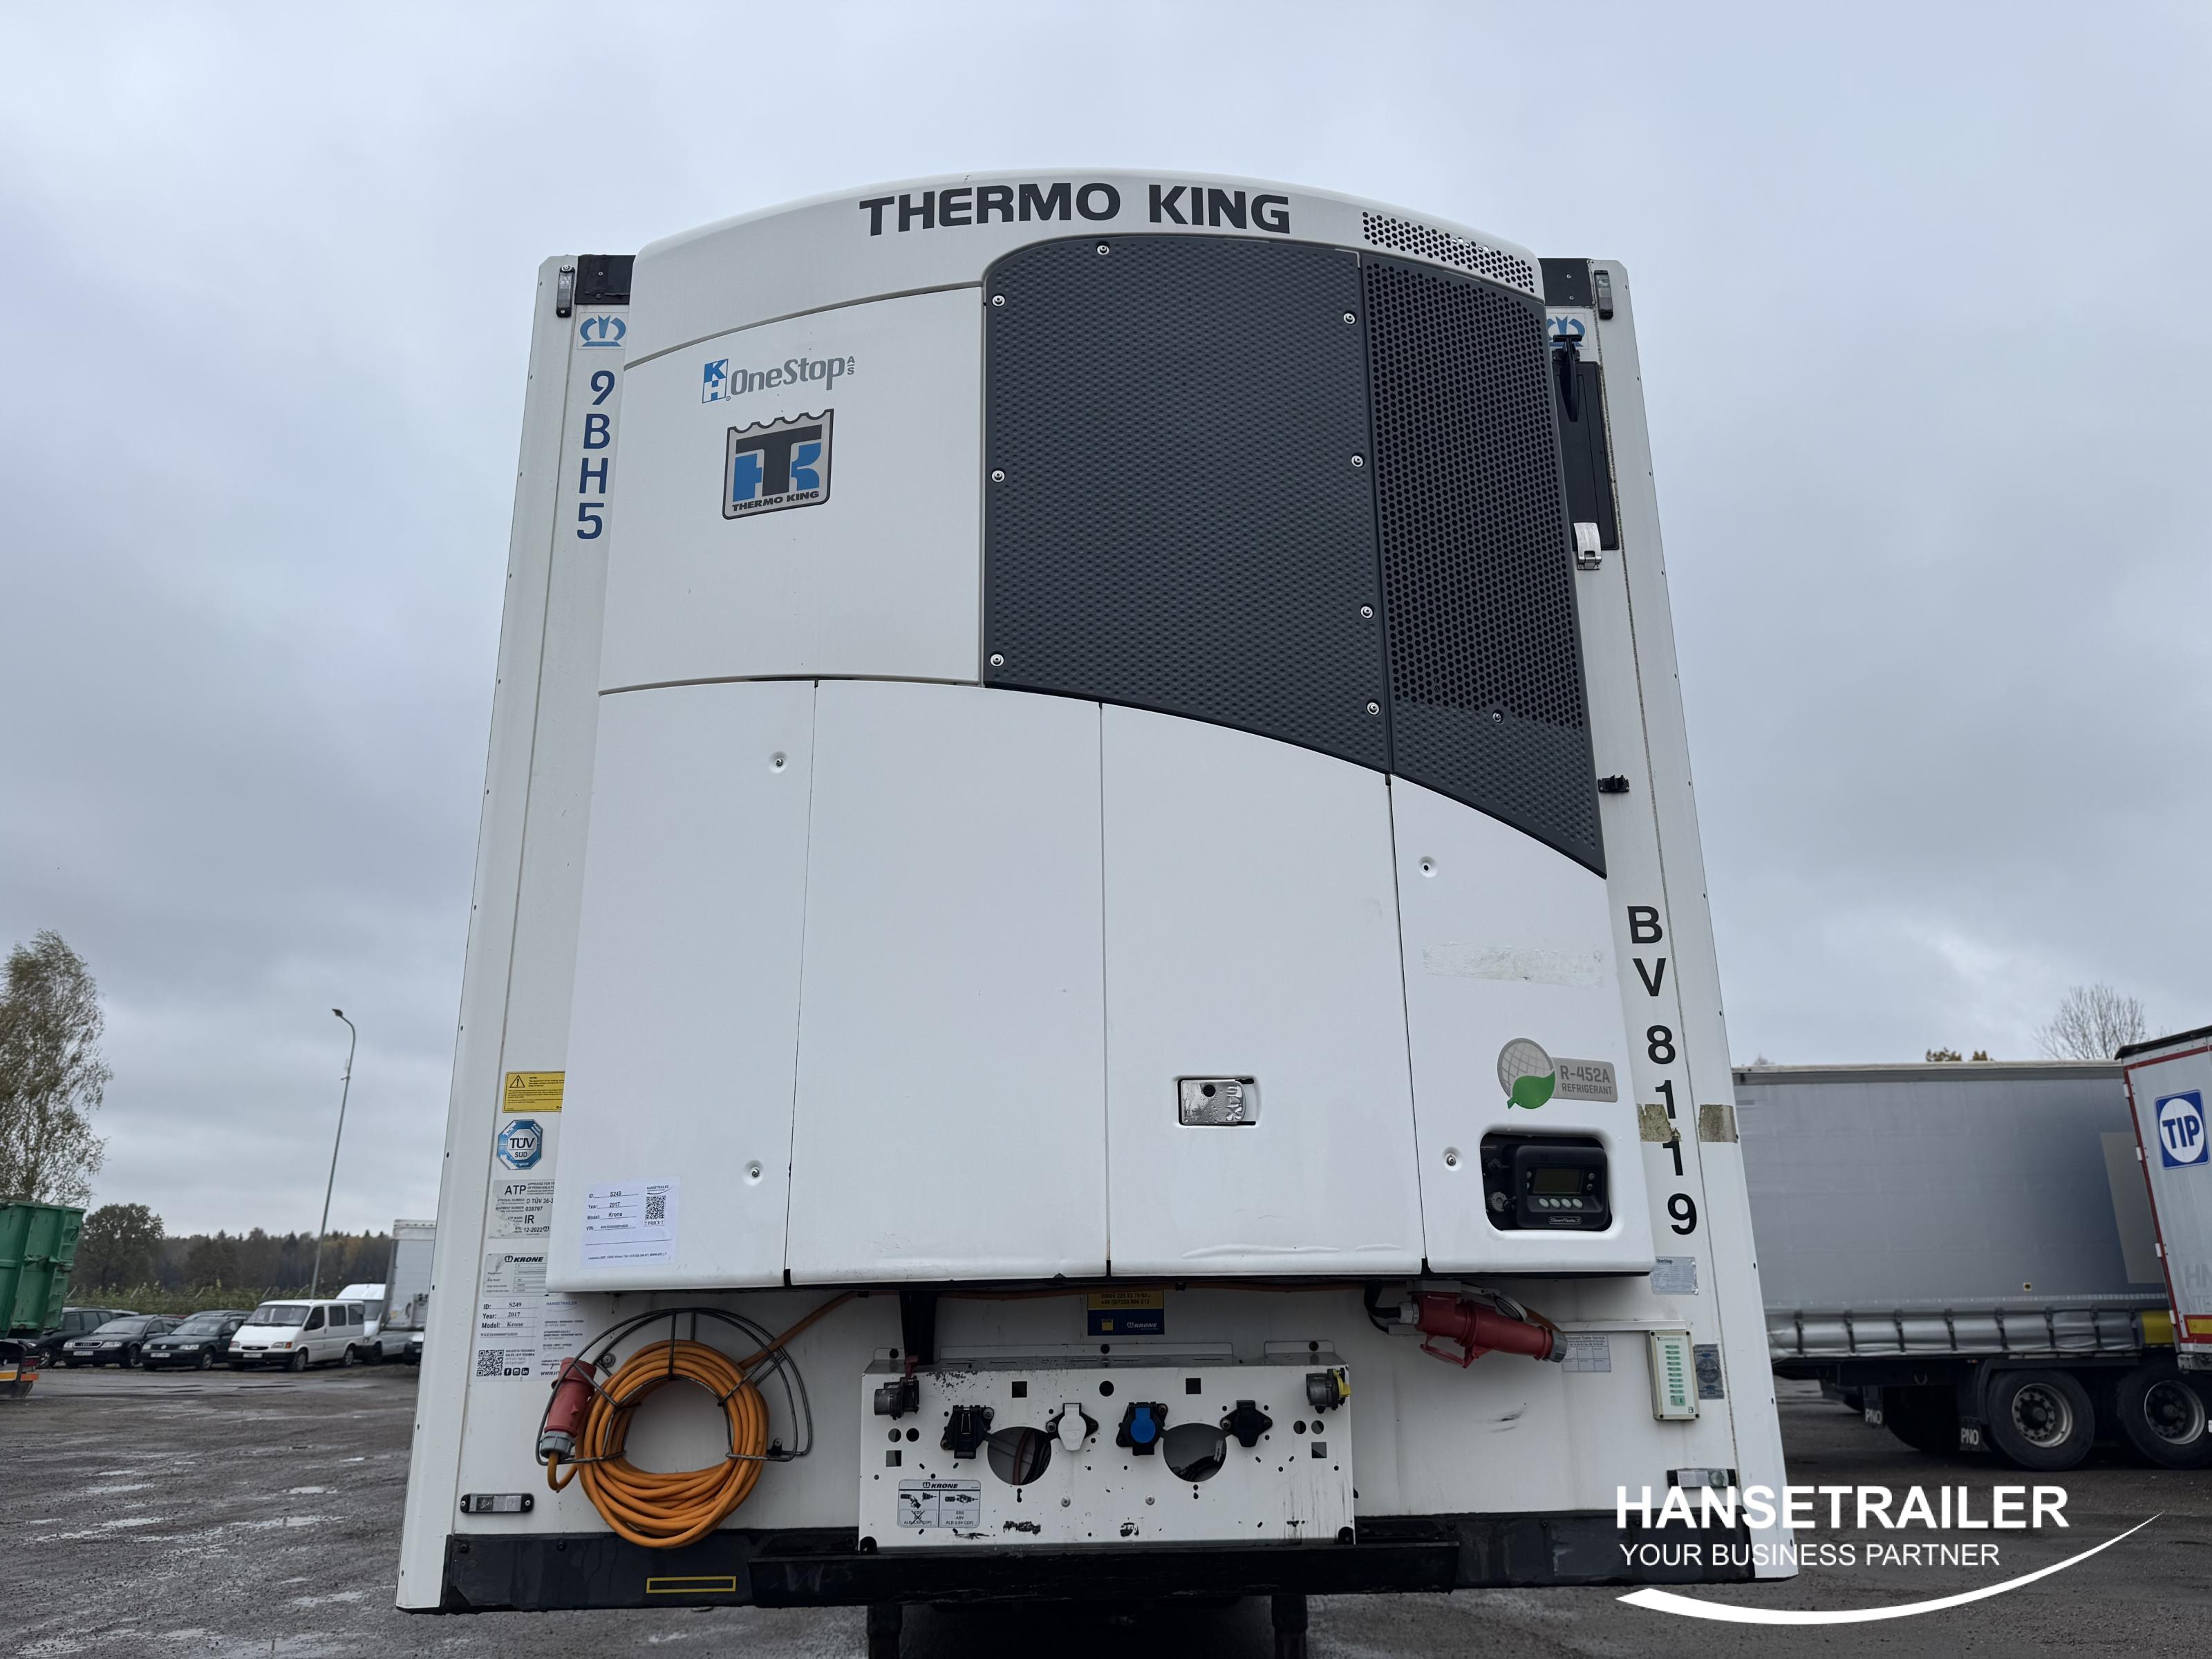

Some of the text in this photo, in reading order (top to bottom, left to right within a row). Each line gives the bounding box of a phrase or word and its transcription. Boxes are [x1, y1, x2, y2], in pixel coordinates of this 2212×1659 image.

[859, 182, 1290, 236] THERMO KING
[731, 357, 845, 395] OneStop
[732, 491, 819, 512] THERMO KING
[1560, 1065, 1611, 1083] R-452A
[1562, 1082, 1612, 1095] REFRIGERANT
[2162, 1114, 2200, 1149] TIP
[509, 1138, 535, 1148] TÜV
[505, 1185, 526, 1194] ATP
[525, 1215, 534, 1224] IR
[1865, 1409, 1882, 1424] PNO
[1961, 1428, 1979, 1445] PNO
